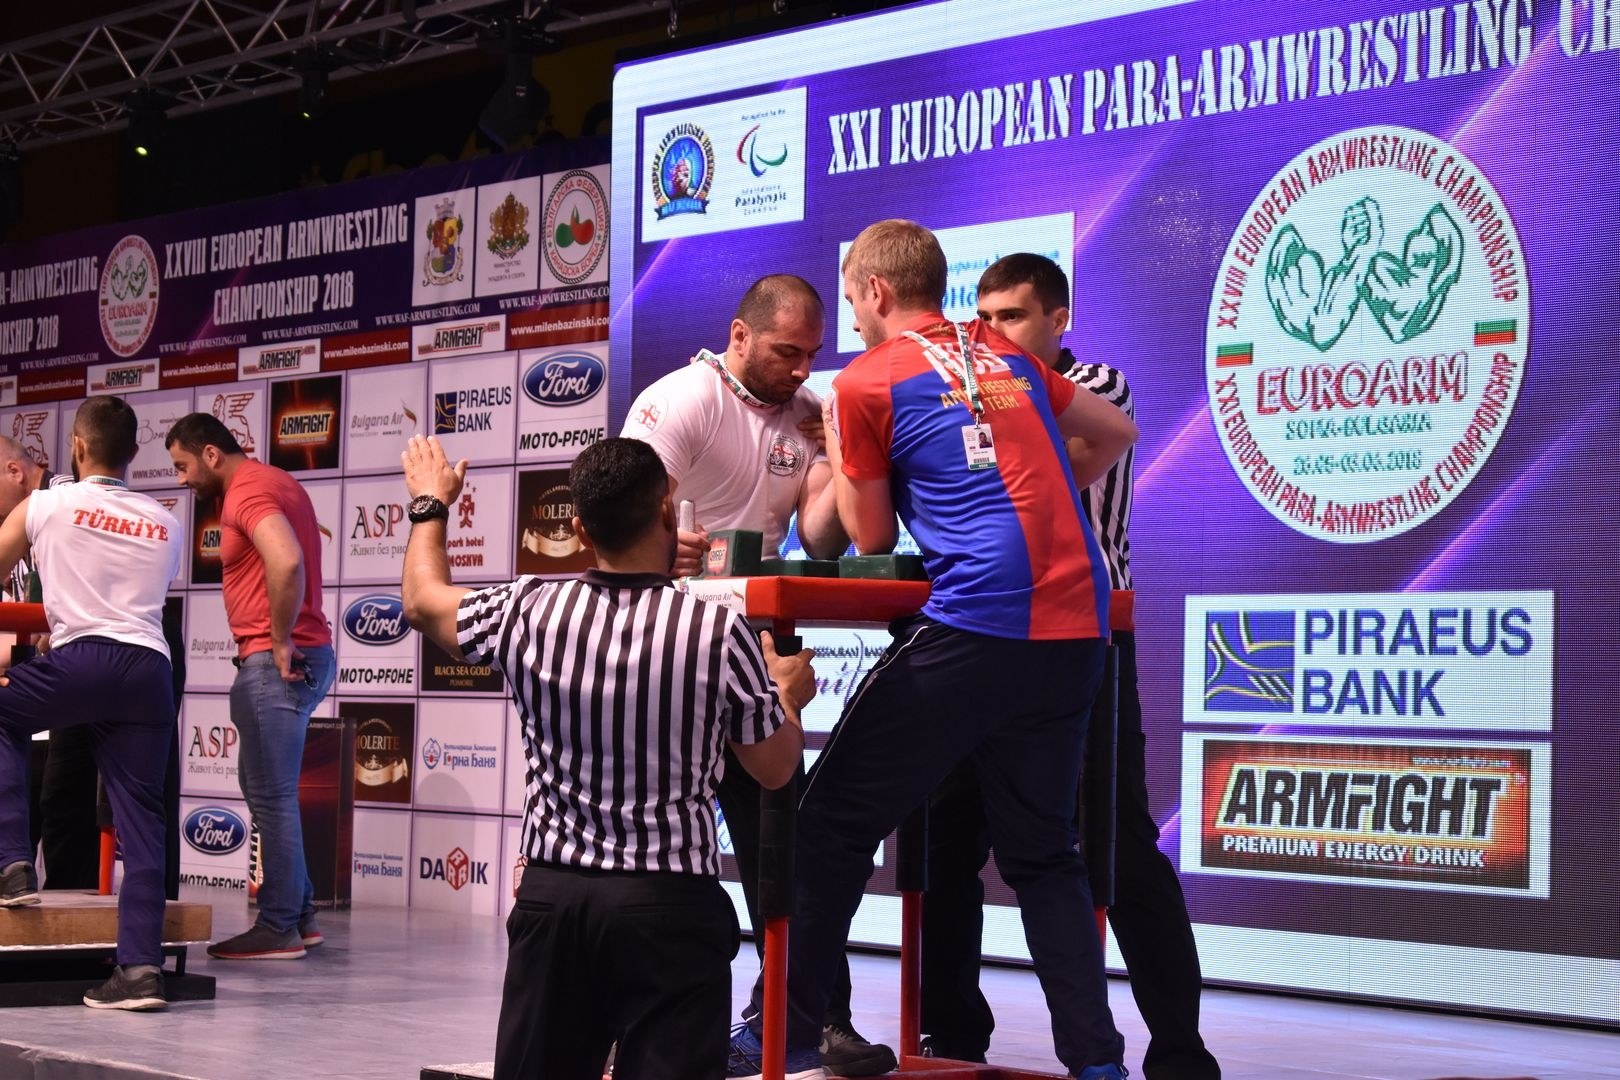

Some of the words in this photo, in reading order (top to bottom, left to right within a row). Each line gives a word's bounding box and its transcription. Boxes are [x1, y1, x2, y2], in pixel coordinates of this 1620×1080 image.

[828, 108, 881, 175] XXI
[889, 73, 1075, 166] EUROPEAN
[1080, 0, 1535, 135] PARA-ARMWRESTLING
[1234, 167, 1307, 268] EUROPEAN
[1306, 134, 1438, 189] ARMWRESTLING
[1434, 155, 1520, 303] CHAMPIONSHIP
[164, 237, 208, 280] XXVIII
[210, 224, 283, 272] EUROPEAN
[286, 202, 408, 260] ARMWRESTLING
[213, 272, 319, 326] CHAMPIONSHIP
[322, 270, 354, 312] 2018
[499, 284, 610, 310] WWW.WAF-ARMWRESTLING.CO
[0, 318, 34, 355] NSHIP
[36, 314, 60, 351] 2018
[433, 326, 484, 350] ARMFIGHT
[258, 349, 302, 371] ARMFIGHT
[538, 360, 592, 398] Ford
[1255, 350, 1469, 416] EUROARM
[458, 386, 512, 409] PIRAEUS
[984, 395, 1020, 412] TEAM
[278, 412, 331, 436] ARMFIGHT
[457, 411, 492, 433] BANK
[1221, 408, 1285, 506] EUROPEAN
[1434, 351, 1518, 493] CHAMPIONSHIP
[131, 469, 179, 480] WWW.BONITAS.B
[73, 508, 169, 542] TÜRKİYE
[350, 503, 404, 539] ASP
[532, 503, 575, 520] MOLERI
[465, 536, 485, 547] hotel
[355, 602, 402, 637] Ford
[1303, 606, 1534, 657] PIRAEUS
[338, 667, 414, 685] MOTO-PFOHE
[1301, 668, 1446, 717] BANK
[188, 725, 238, 759] ASP
[1223, 767, 1502, 839] ARMFIGHT
[194, 812, 236, 848] Ford
[1221, 834, 1319, 859] PREMIUM
[1324, 841, 1407, 864] ENERGY
[1413, 847, 1486, 869] DRINK
